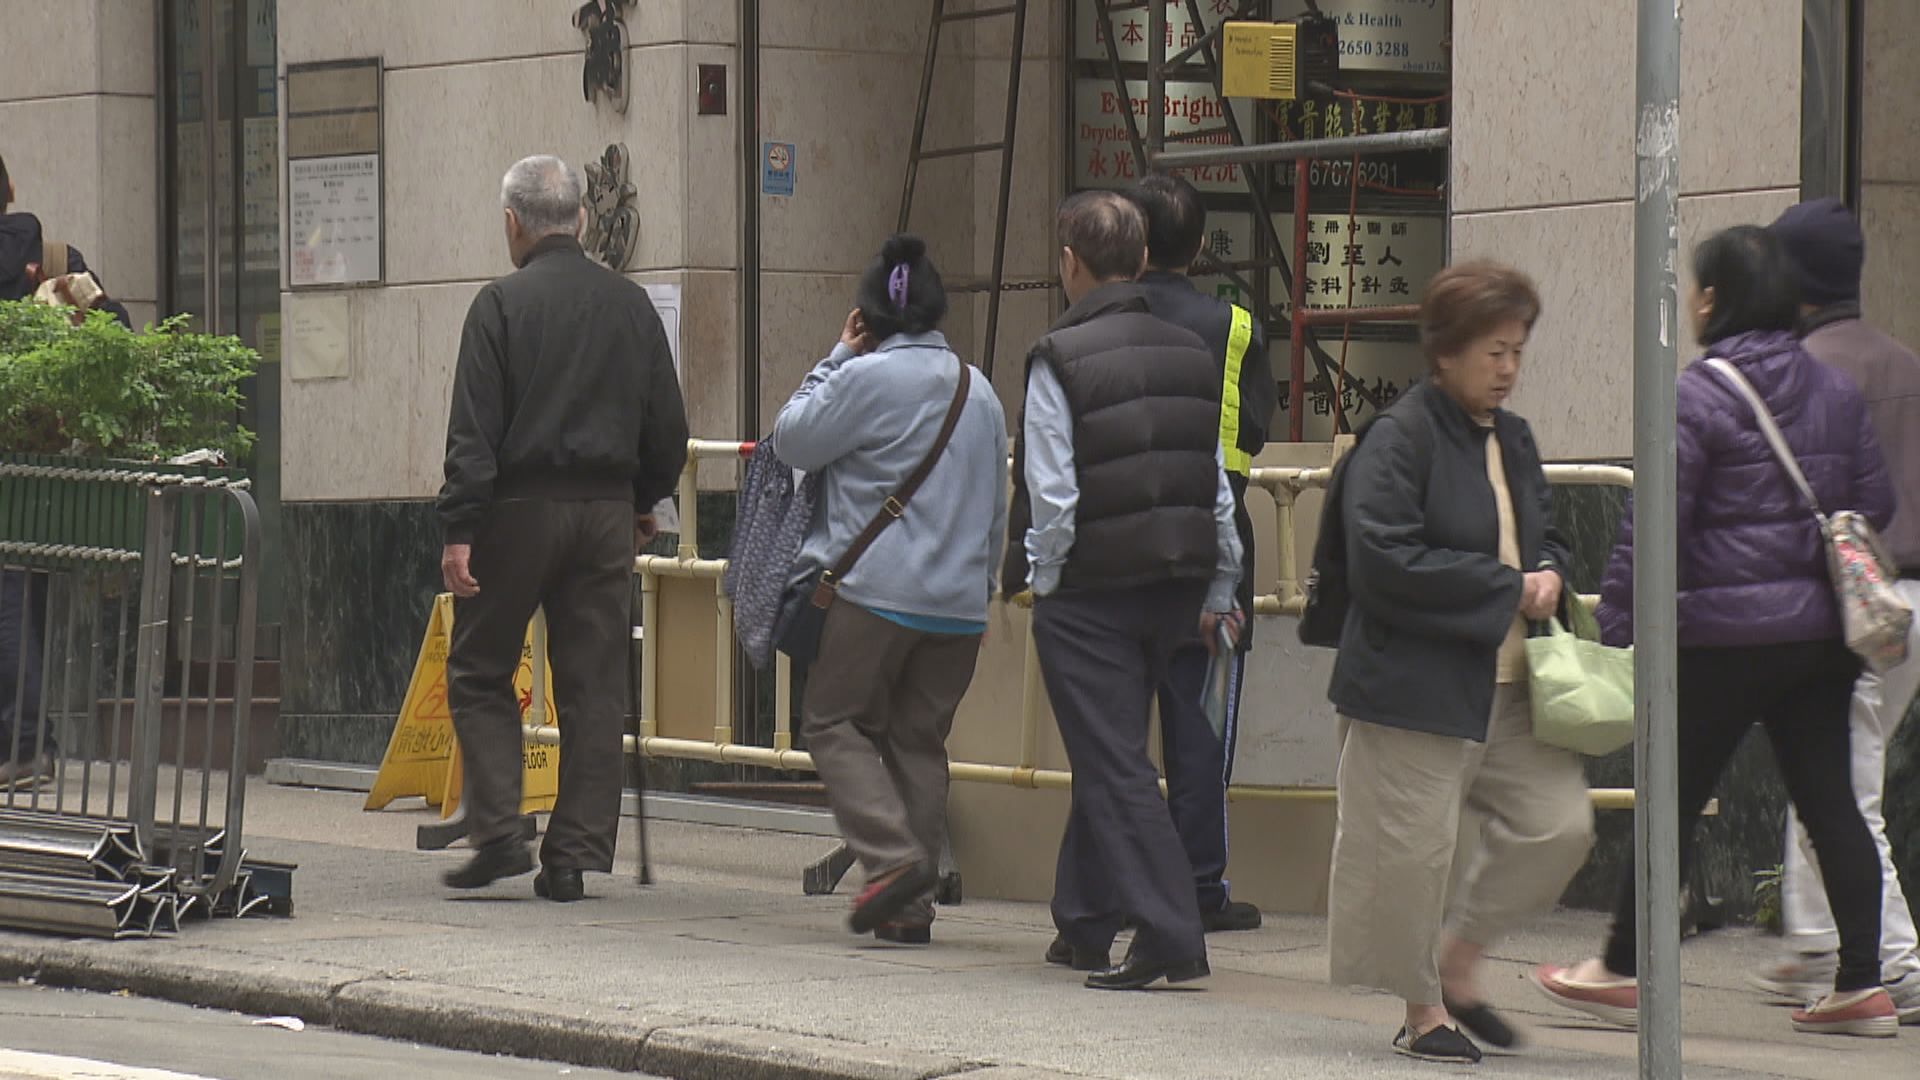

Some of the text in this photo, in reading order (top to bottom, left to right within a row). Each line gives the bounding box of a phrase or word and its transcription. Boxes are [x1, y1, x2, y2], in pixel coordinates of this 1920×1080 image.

[1359, 12, 1402, 28] Health
[1339, 40, 1409, 57] 2650 3288
[1163, 94, 1223, 125] Bright
[1357, 161, 1397, 188] 6291
[522, 751, 548, 769] FLOOR
